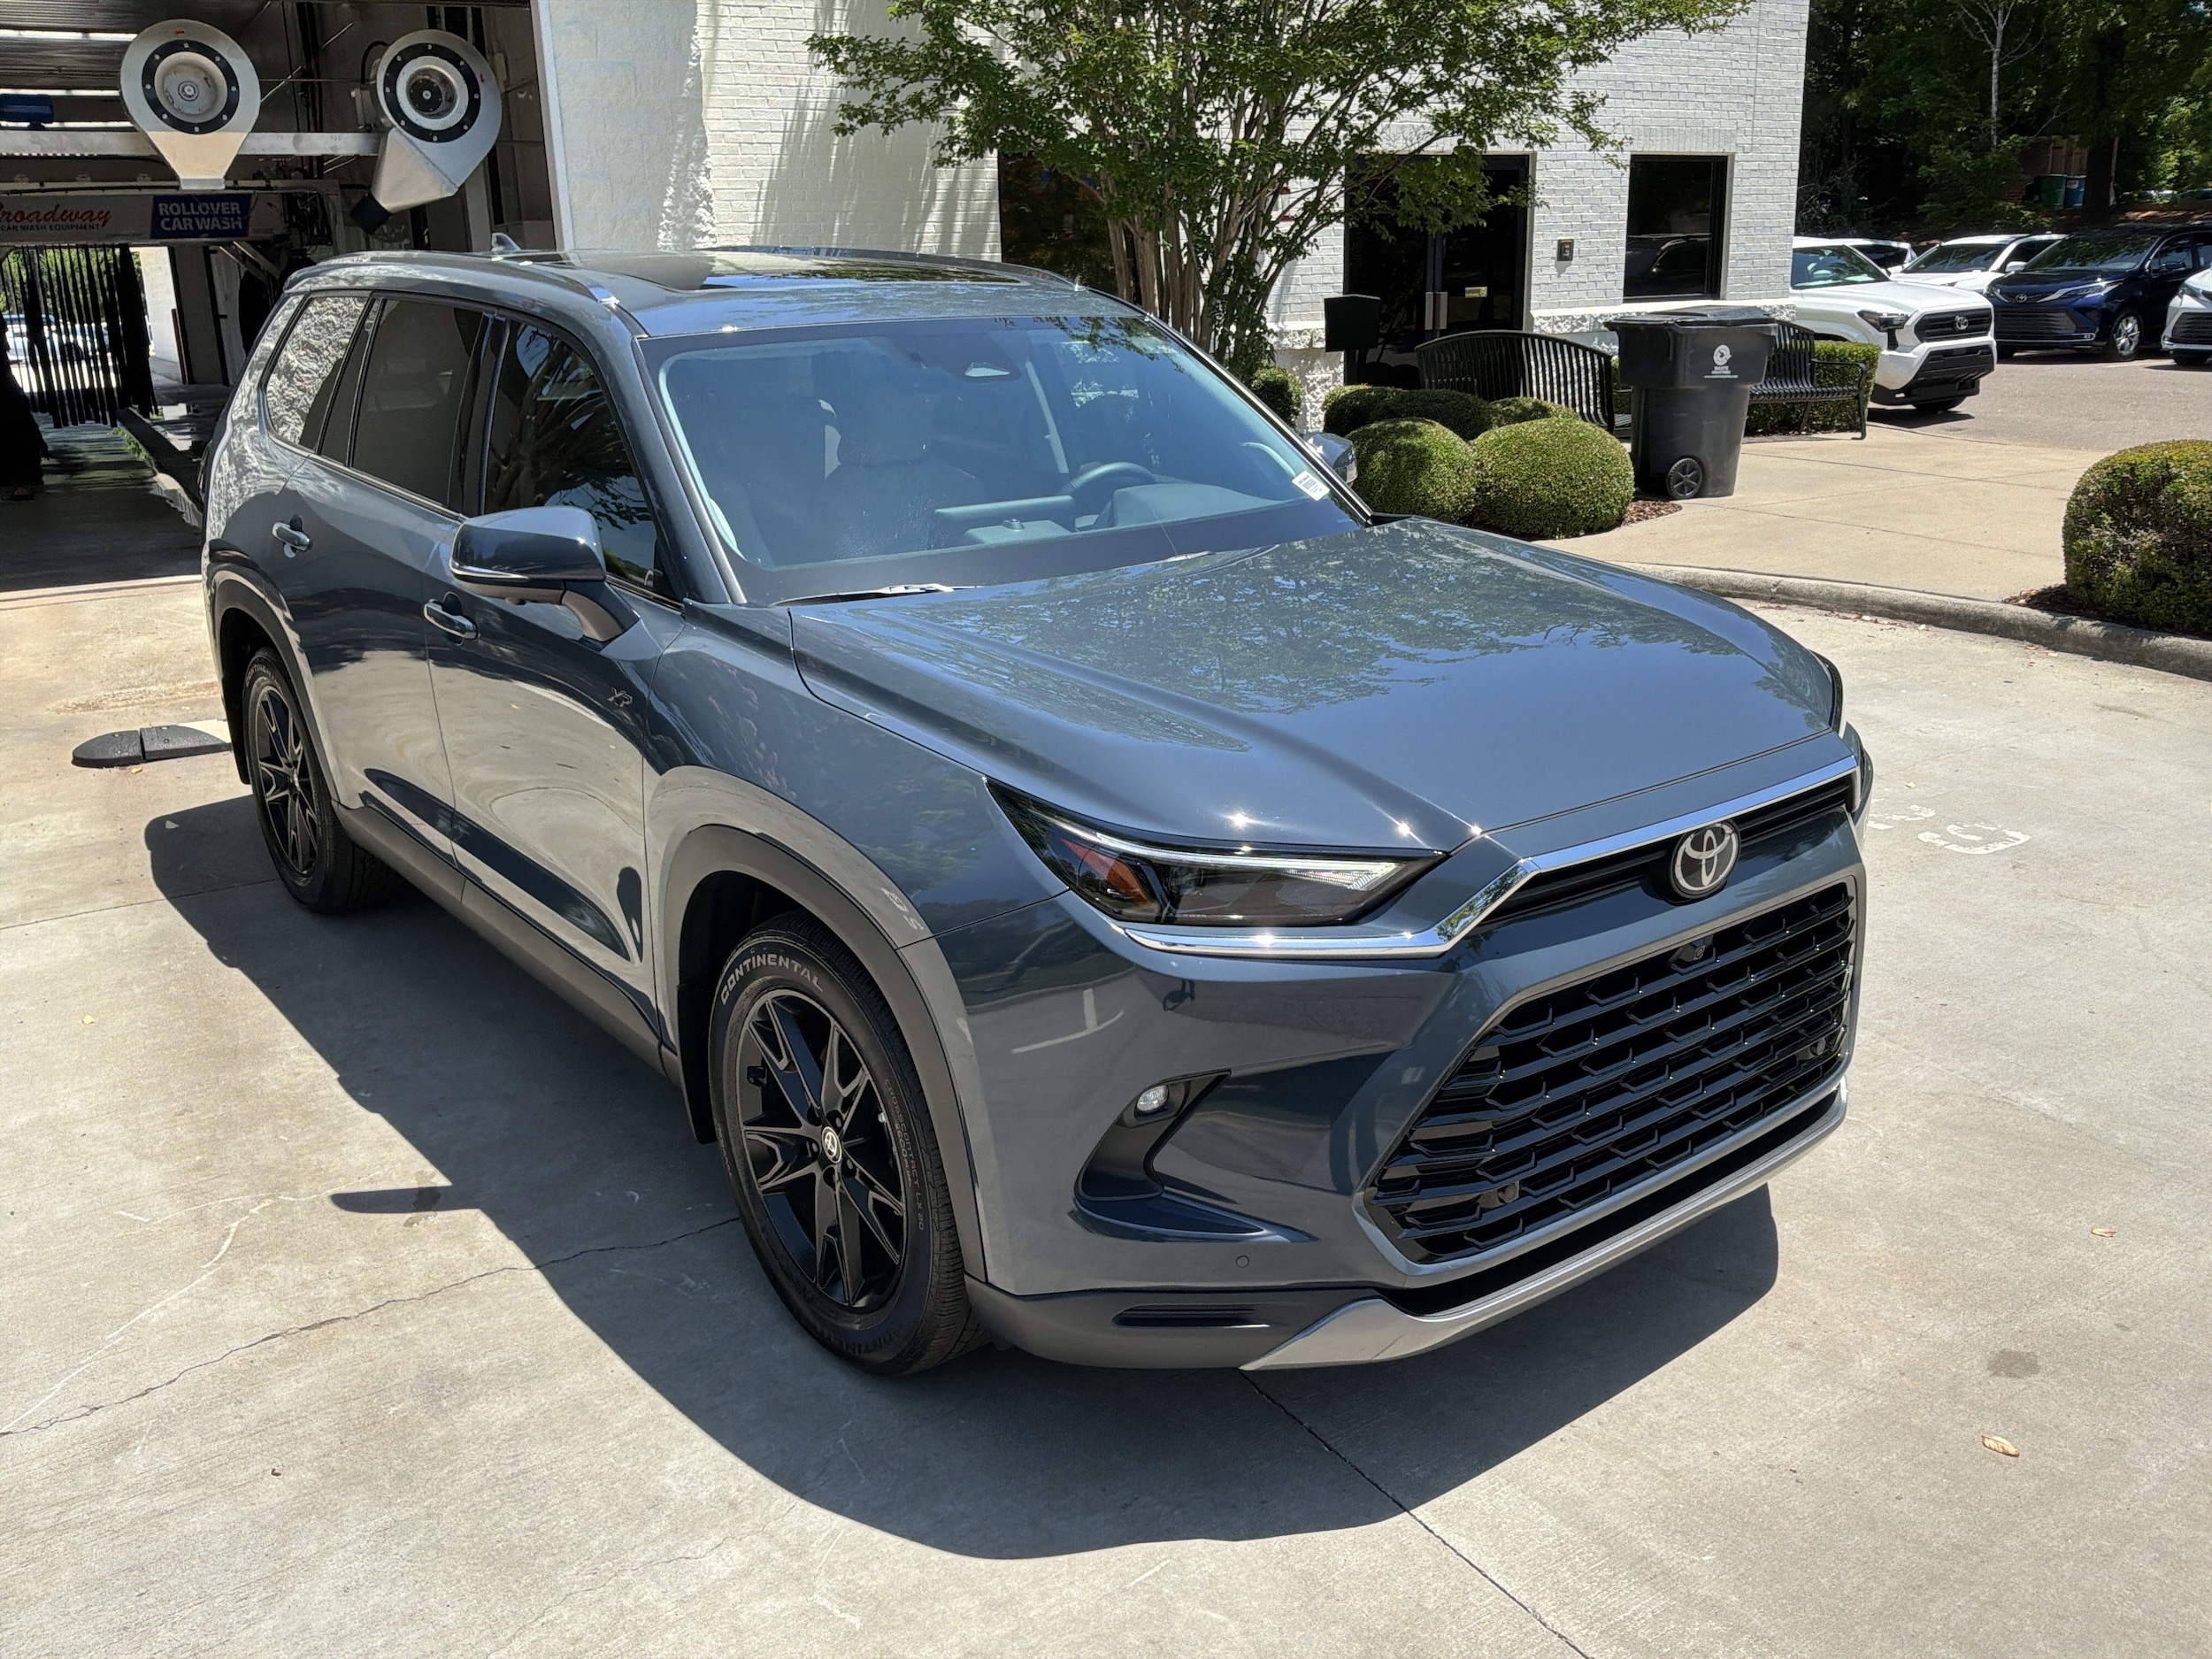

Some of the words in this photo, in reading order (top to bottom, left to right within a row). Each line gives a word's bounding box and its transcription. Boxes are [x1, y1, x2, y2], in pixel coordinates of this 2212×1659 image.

[0, 202, 111, 227] roadway
[158, 202, 241, 216] ROLLOVER
[160, 217, 194, 231] CAR
[195, 216, 242, 230] WASH
[720, 953, 824, 1006] CONTINENTAL
[885, 1079, 920, 1189] CROSSCONTACT
[915, 1192, 923, 1210] LX
[918, 1212, 925, 1231] 20
